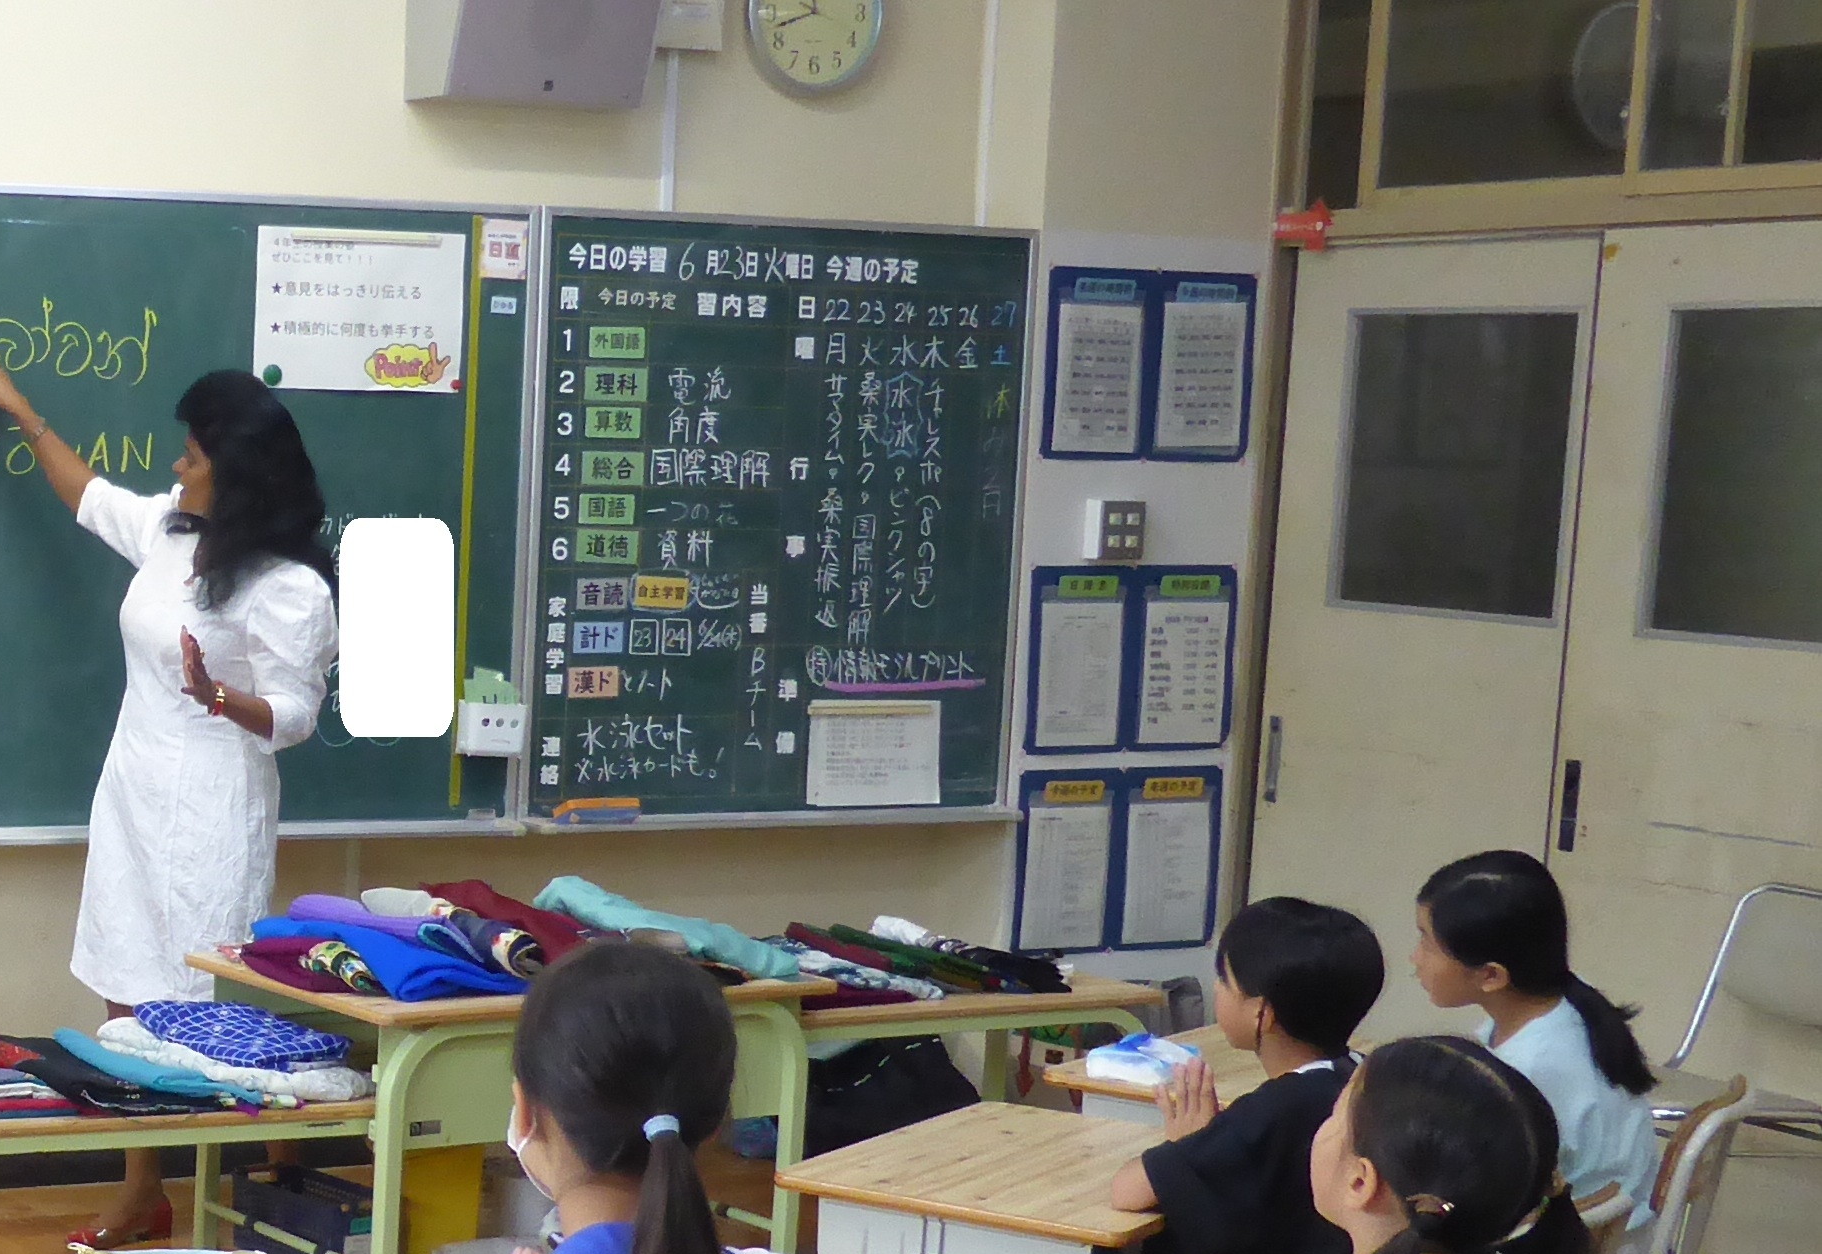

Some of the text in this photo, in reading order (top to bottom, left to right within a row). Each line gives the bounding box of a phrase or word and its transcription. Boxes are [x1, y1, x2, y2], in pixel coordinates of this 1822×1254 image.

[568, 242, 667, 273] 今日の学習
[826, 255, 919, 284] 今週の予定
[560, 286, 768, 318] 限 今日の予定 習内容
[798, 296, 816, 319] 日
[823, 298, 851, 322] 22
[857, 300, 886, 325] 23
[894, 300, 918, 324] 24
[928, 304, 953, 326] 25
[959, 304, 979, 328] 26
[562, 328, 640, 352] 1 外国語
[825, 332, 847, 365] 月
[859, 335, 885, 366] 火
[889, 334, 920, 366] 水
[920, 335, 950, 369] 木
[954, 336, 978, 369] 金
[559, 365, 732, 405] 2 理科 電流
[557, 405, 720, 445] 3 算数 角度
[554, 448, 771, 490] 4 総合 国際理解
[553, 496, 570, 520] 5
[587, 497, 627, 519] 国語
[552, 530, 714, 569] 6 道徳 資料
[581, 581, 625, 607] 音読
[638, 584, 686, 601] 自主学習
[579, 626, 619, 650] 計ド
[574, 669, 614, 694] 漢ド
